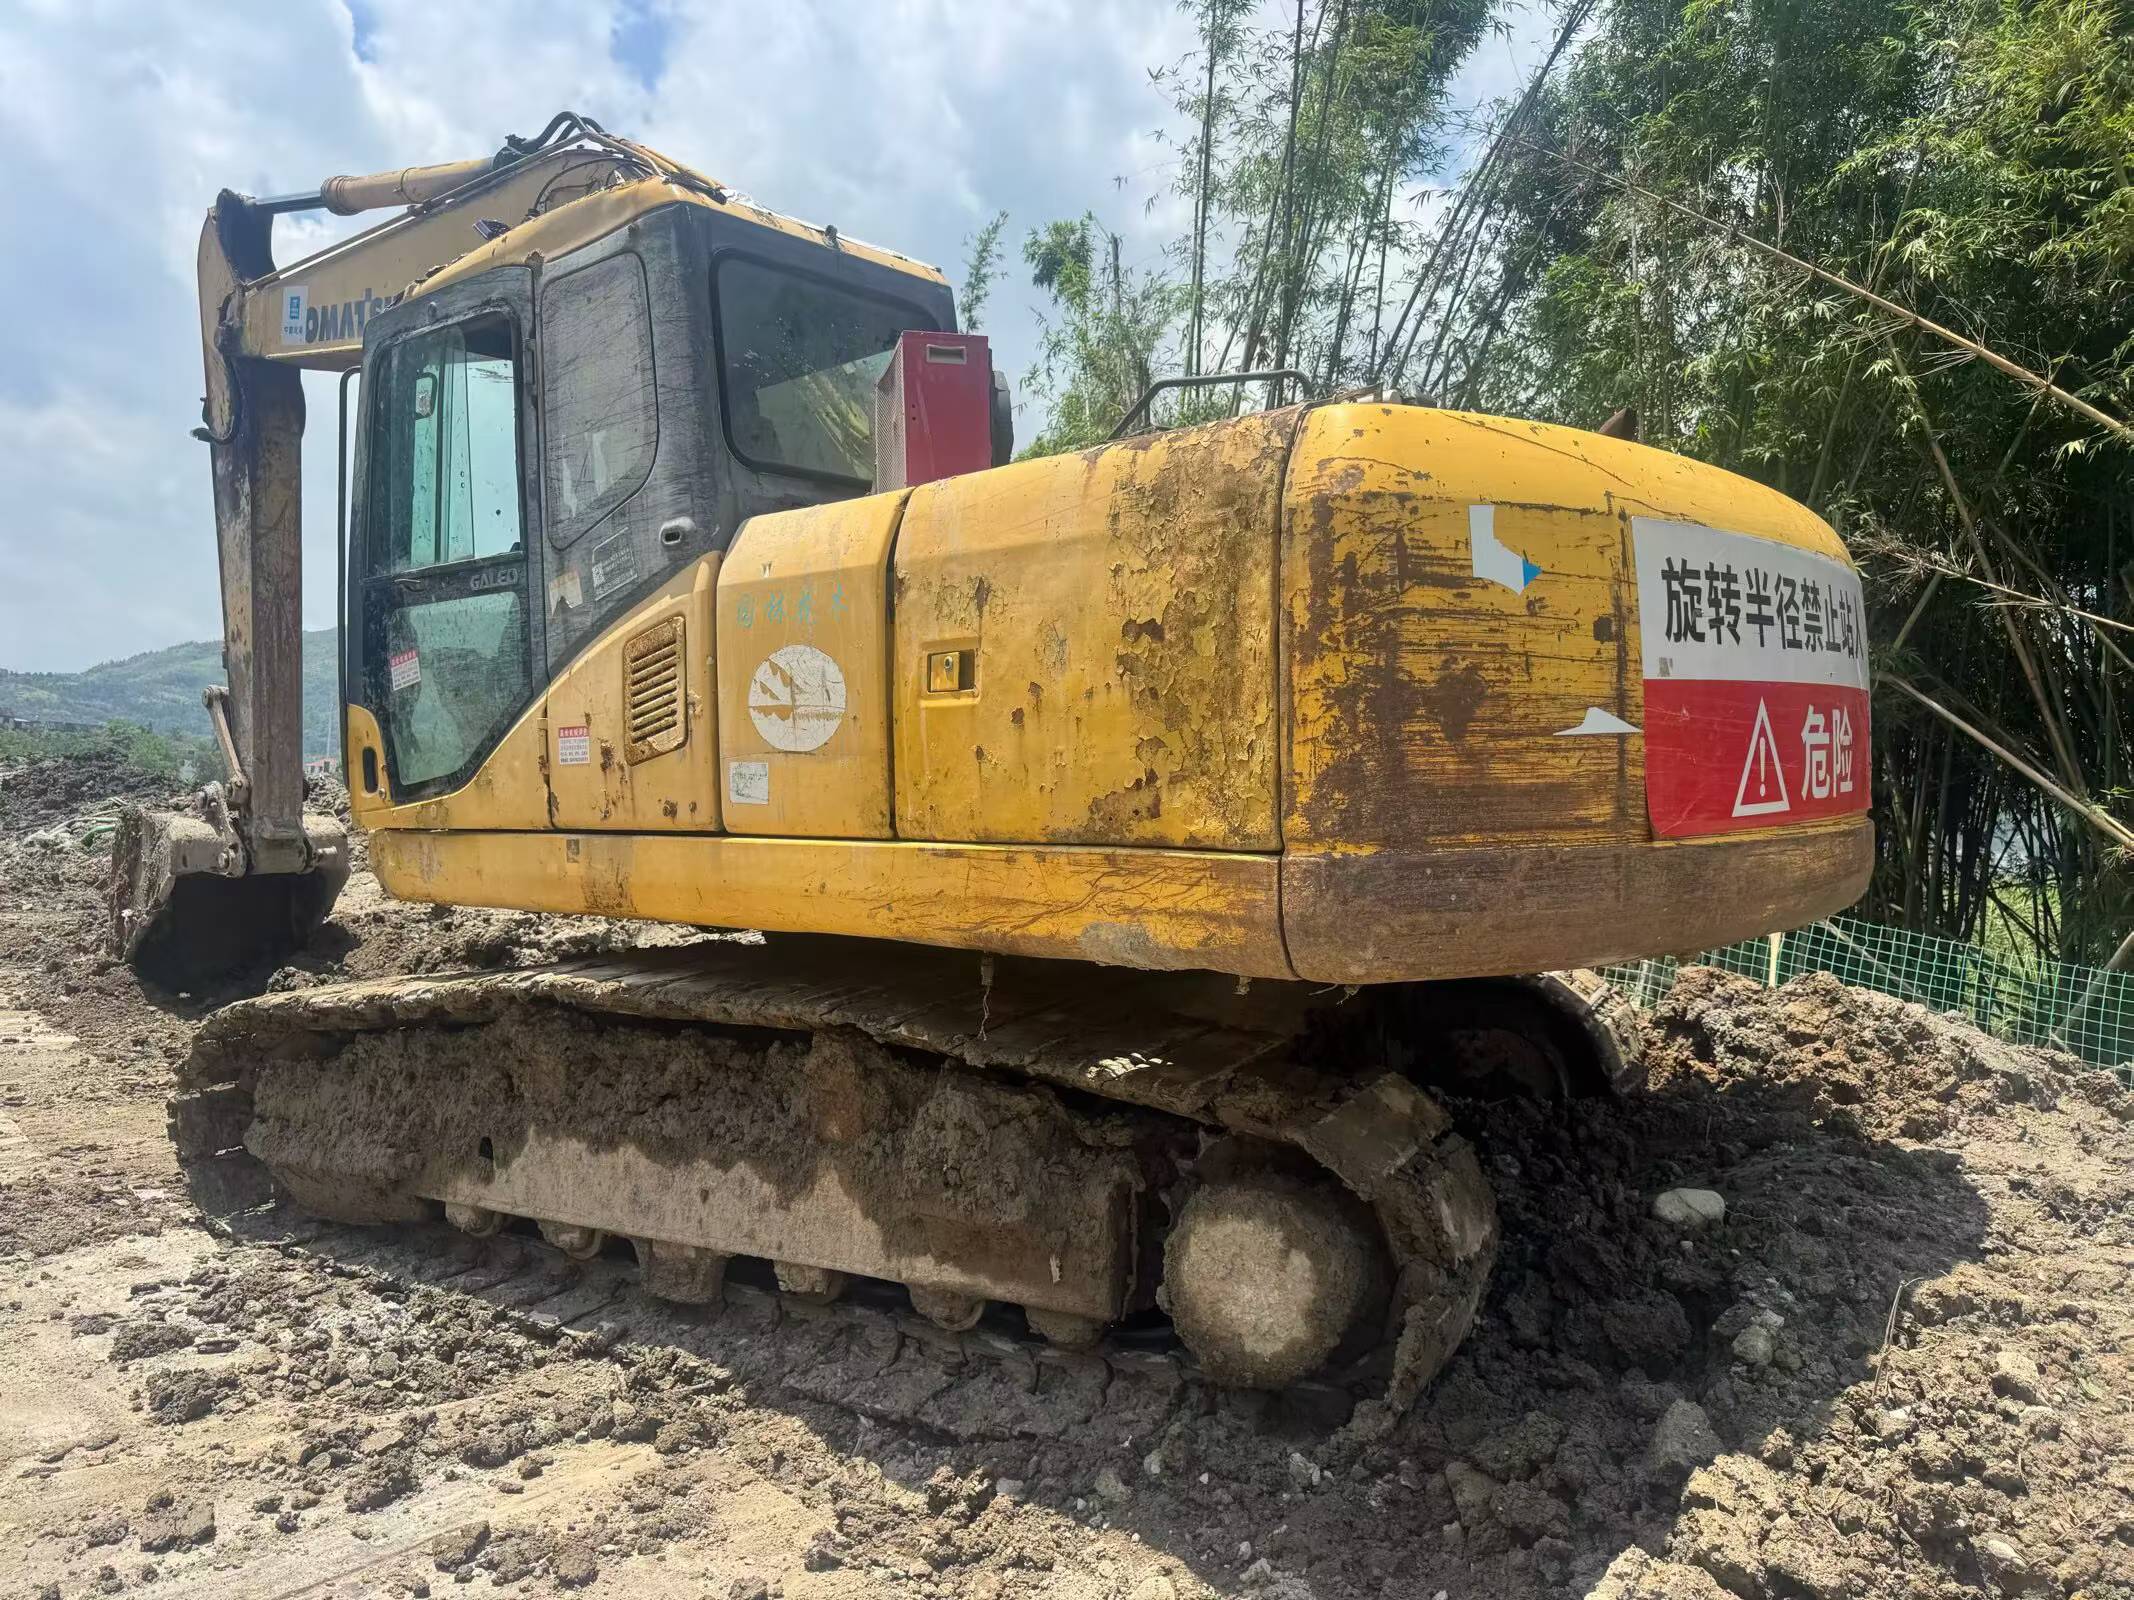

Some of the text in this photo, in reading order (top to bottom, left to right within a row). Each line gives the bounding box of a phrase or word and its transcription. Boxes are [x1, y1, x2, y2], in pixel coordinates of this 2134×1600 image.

[470, 568, 518, 590] GALEO
[1661, 556, 1864, 660] 旋转半径禁止站人
[1801, 704, 1853, 800] 危险
